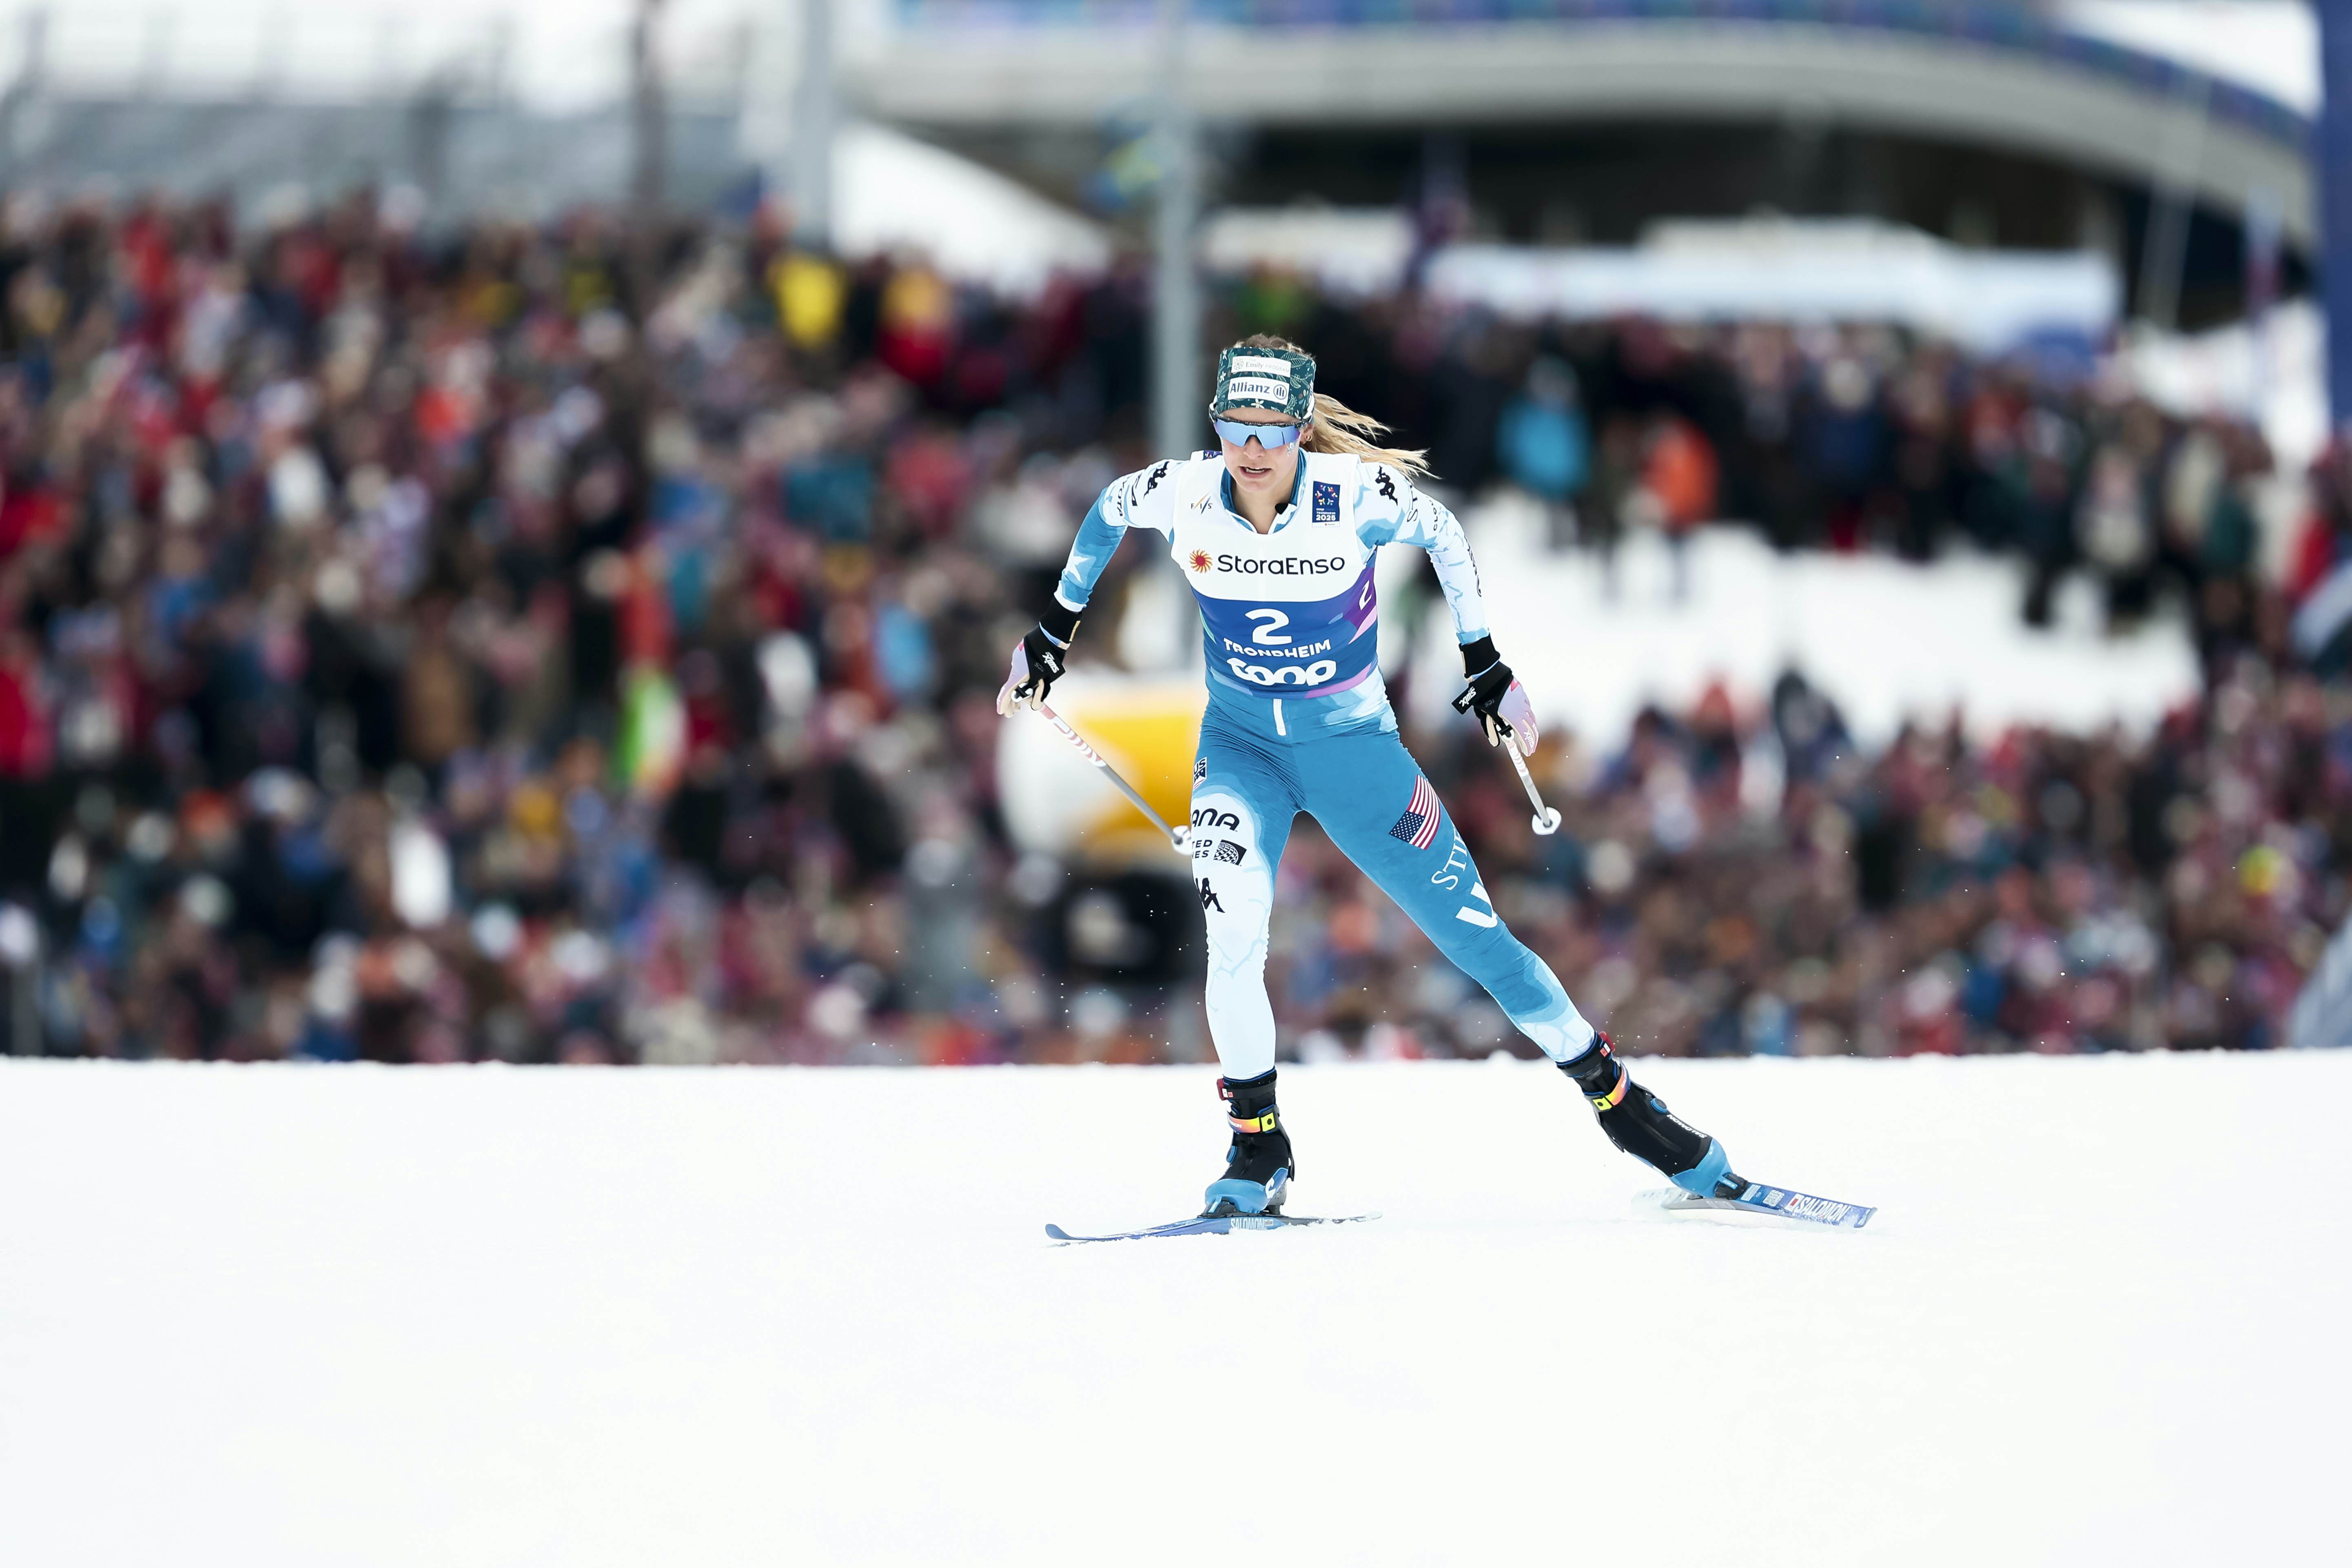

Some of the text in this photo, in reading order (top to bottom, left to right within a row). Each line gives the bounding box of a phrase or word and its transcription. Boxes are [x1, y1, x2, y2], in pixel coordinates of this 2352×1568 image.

[1265, 364, 1290, 373] PROGRAM
[1230, 382, 1270, 394] Allianz
[1217, 554, 1345, 575] StoraEnso
[1245, 608, 1292, 645] 2
[1223, 637, 1332, 658] TRONDHEIM
[1193, 758, 1206, 774] US
[1667, 1114, 1707, 1138] SALOMON
[1797, 1196, 1851, 1221] SALOMON
[1230, 1218, 1264, 1230] SALOMON
